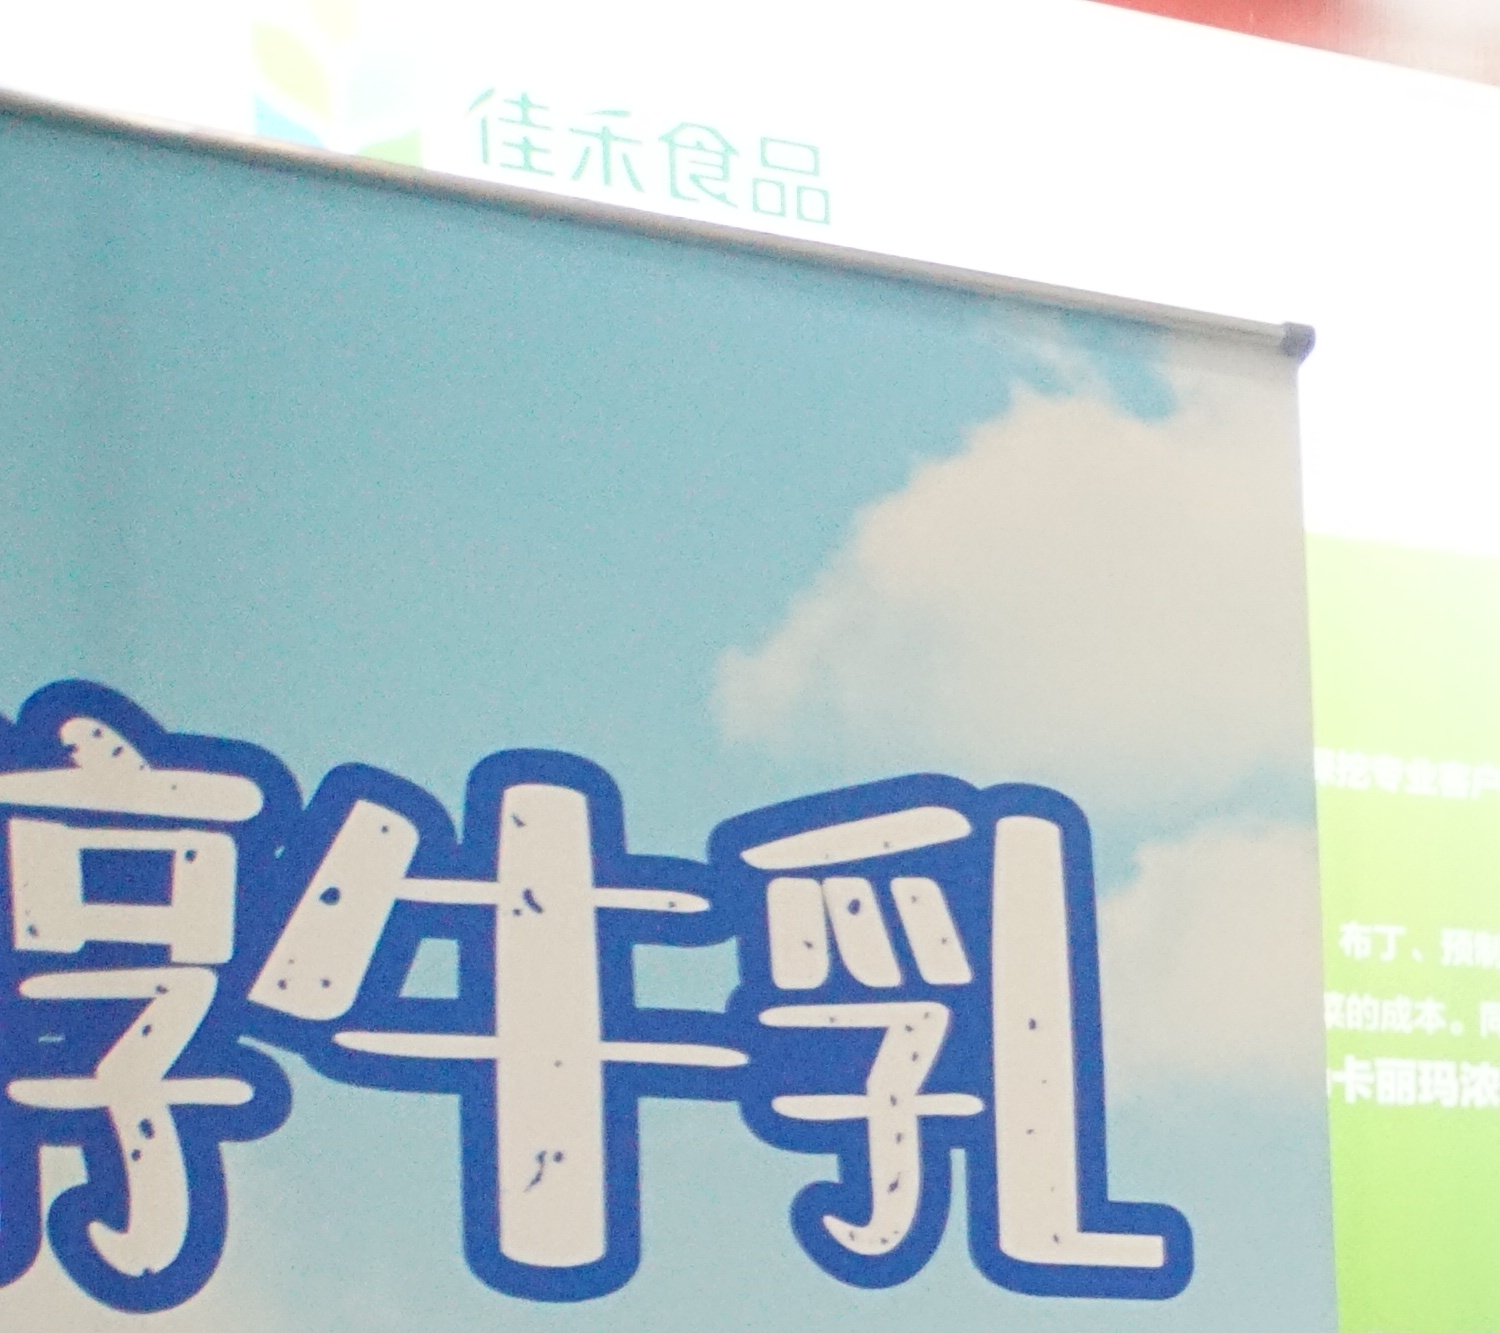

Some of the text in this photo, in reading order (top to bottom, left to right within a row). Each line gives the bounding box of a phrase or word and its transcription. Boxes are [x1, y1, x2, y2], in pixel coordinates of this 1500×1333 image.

[467, 85, 831, 225] 佳禾食品
[0, 690, 1180, 1300] 享牛乳
